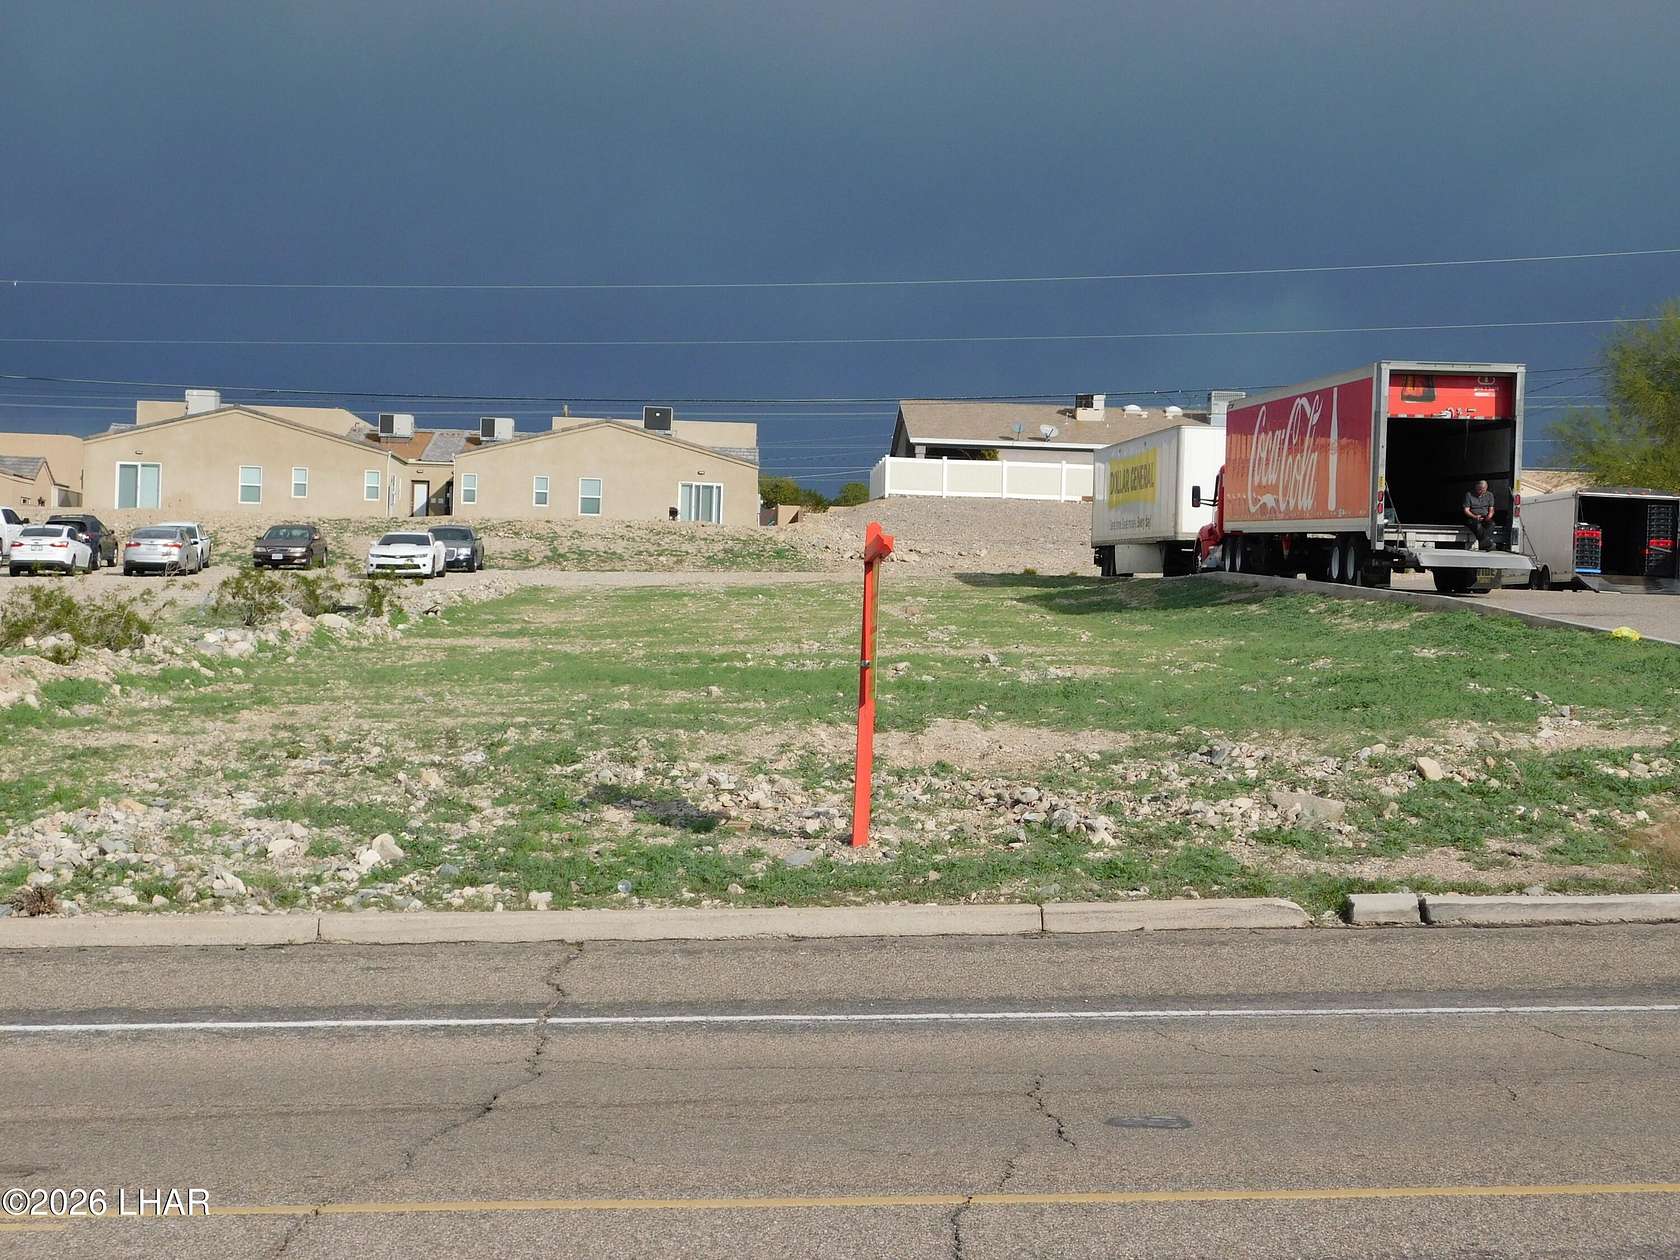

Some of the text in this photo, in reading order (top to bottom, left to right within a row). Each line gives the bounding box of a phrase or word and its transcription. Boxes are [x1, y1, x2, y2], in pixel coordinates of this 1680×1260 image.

[1110, 462, 1154, 496] DOLLAR GENERAL
[1248, 394, 1323, 513] Coca-Cola
